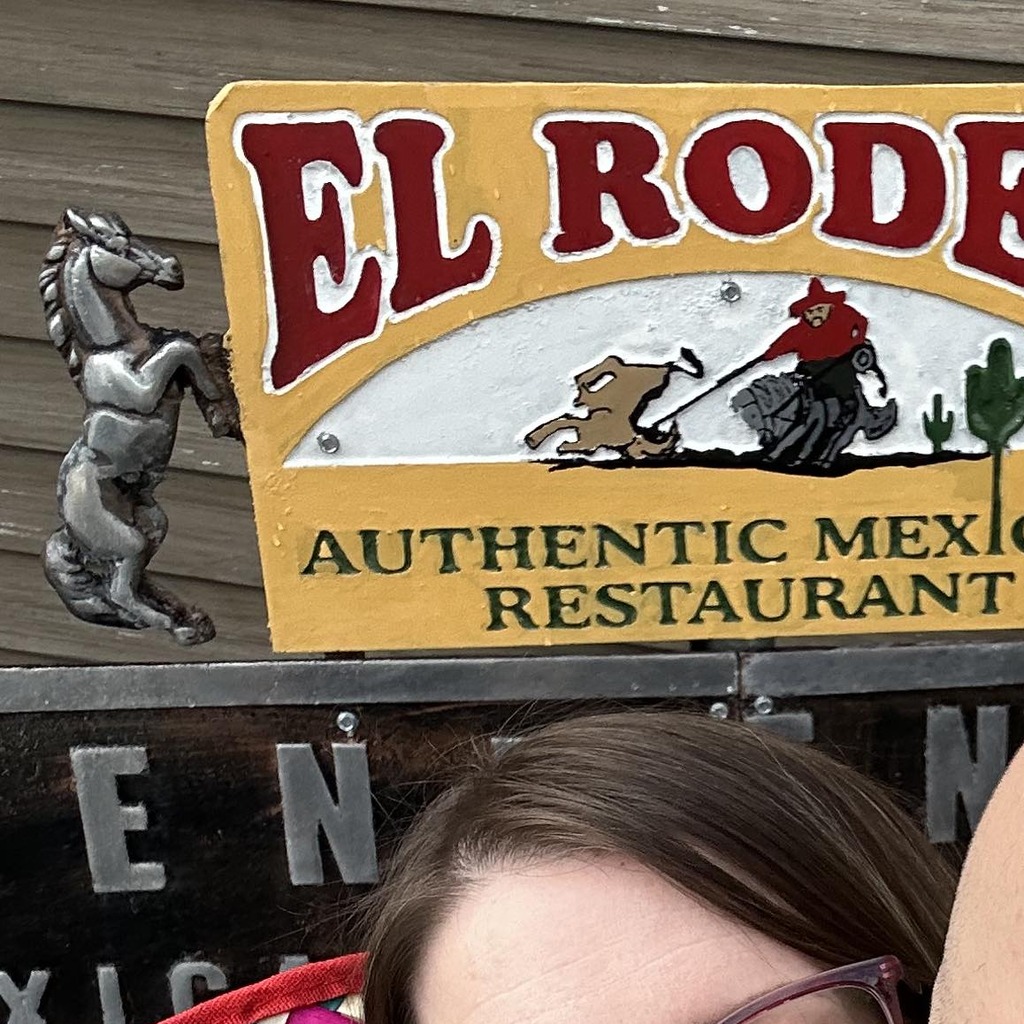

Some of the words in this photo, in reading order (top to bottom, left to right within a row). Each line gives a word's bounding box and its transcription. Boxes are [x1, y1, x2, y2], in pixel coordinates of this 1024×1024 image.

[242, 118, 493, 387] EL
[300, 517, 788, 576] AUTHENTIC
[484, 571, 1016, 632] RESTAURANT
